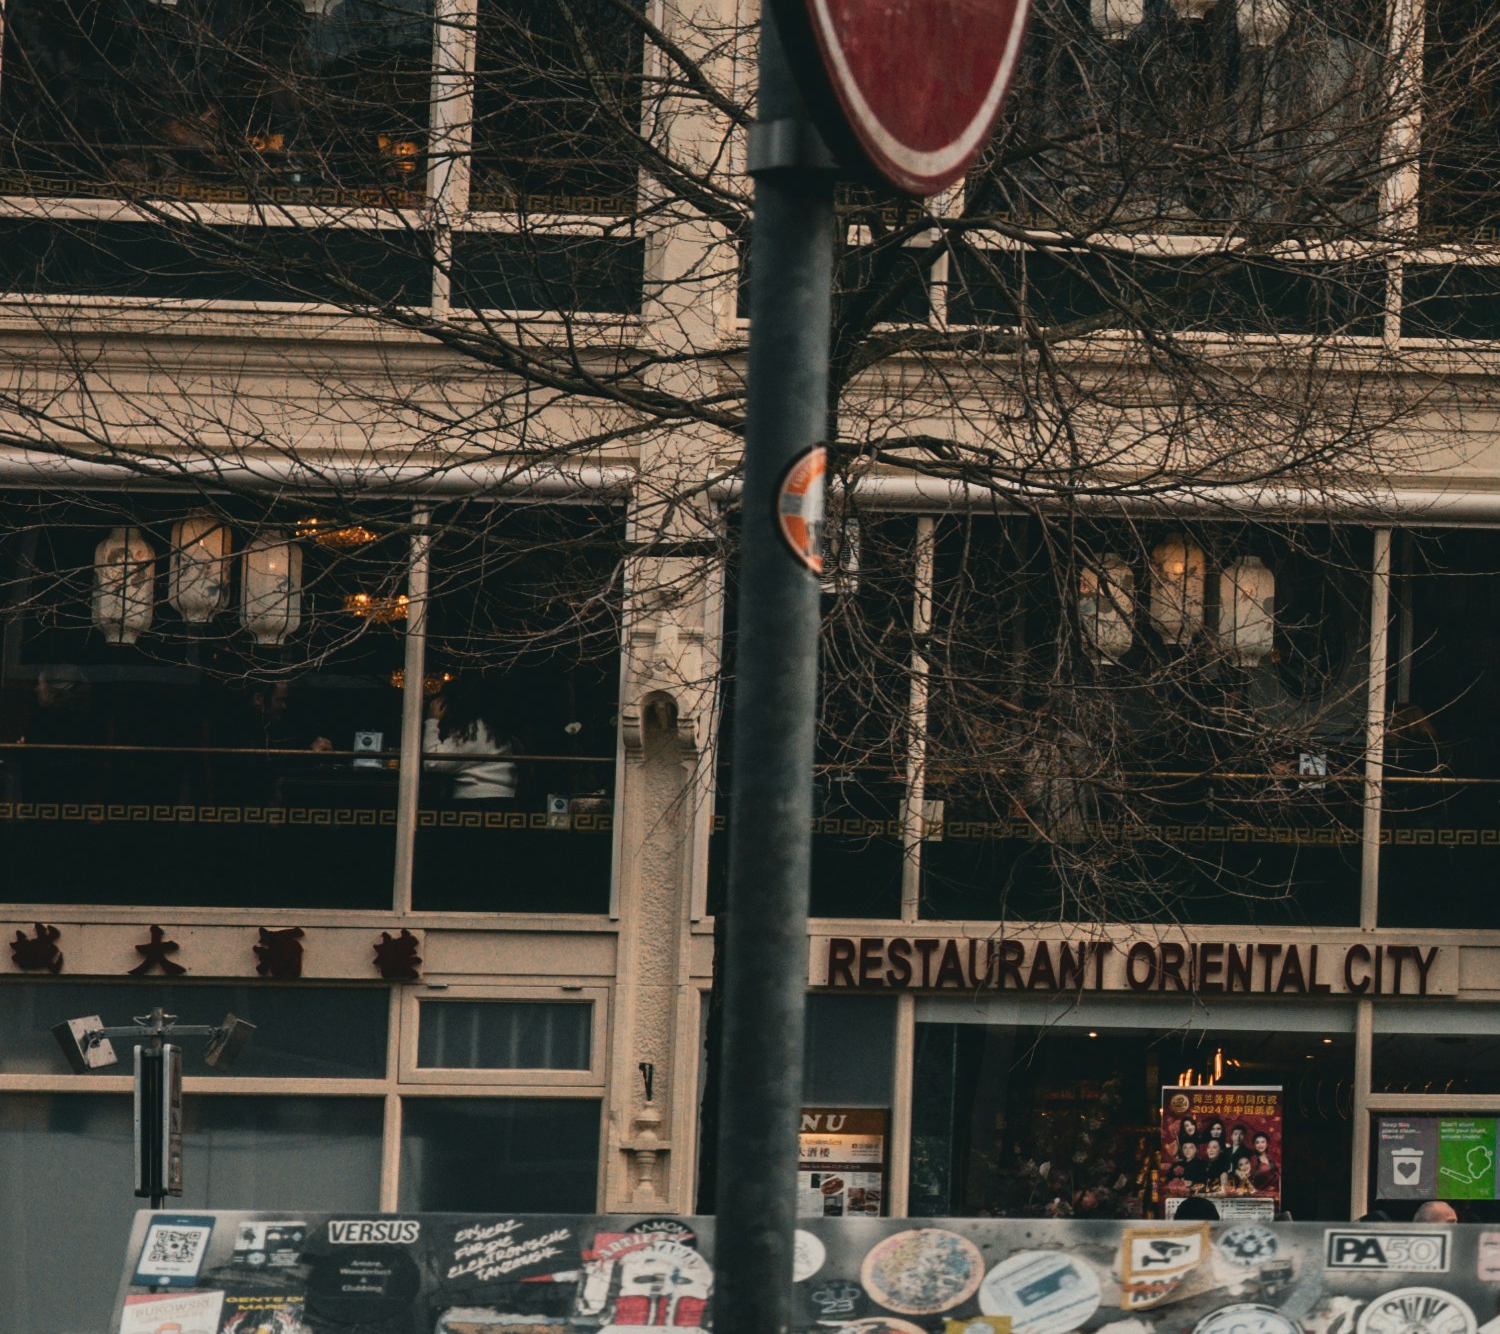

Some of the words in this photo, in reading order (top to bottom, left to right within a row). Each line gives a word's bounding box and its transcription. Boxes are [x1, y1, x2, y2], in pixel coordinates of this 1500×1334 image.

[828, 937, 1113, 992] RESTAURANT
[1126, 940, 1330, 995] ORIENTAL
[1344, 944, 1440, 996] CITY
[801, 1114, 847, 1132] NU
[328, 1220, 420, 1244] VERSUS
[821, 1300, 854, 1314] 23
